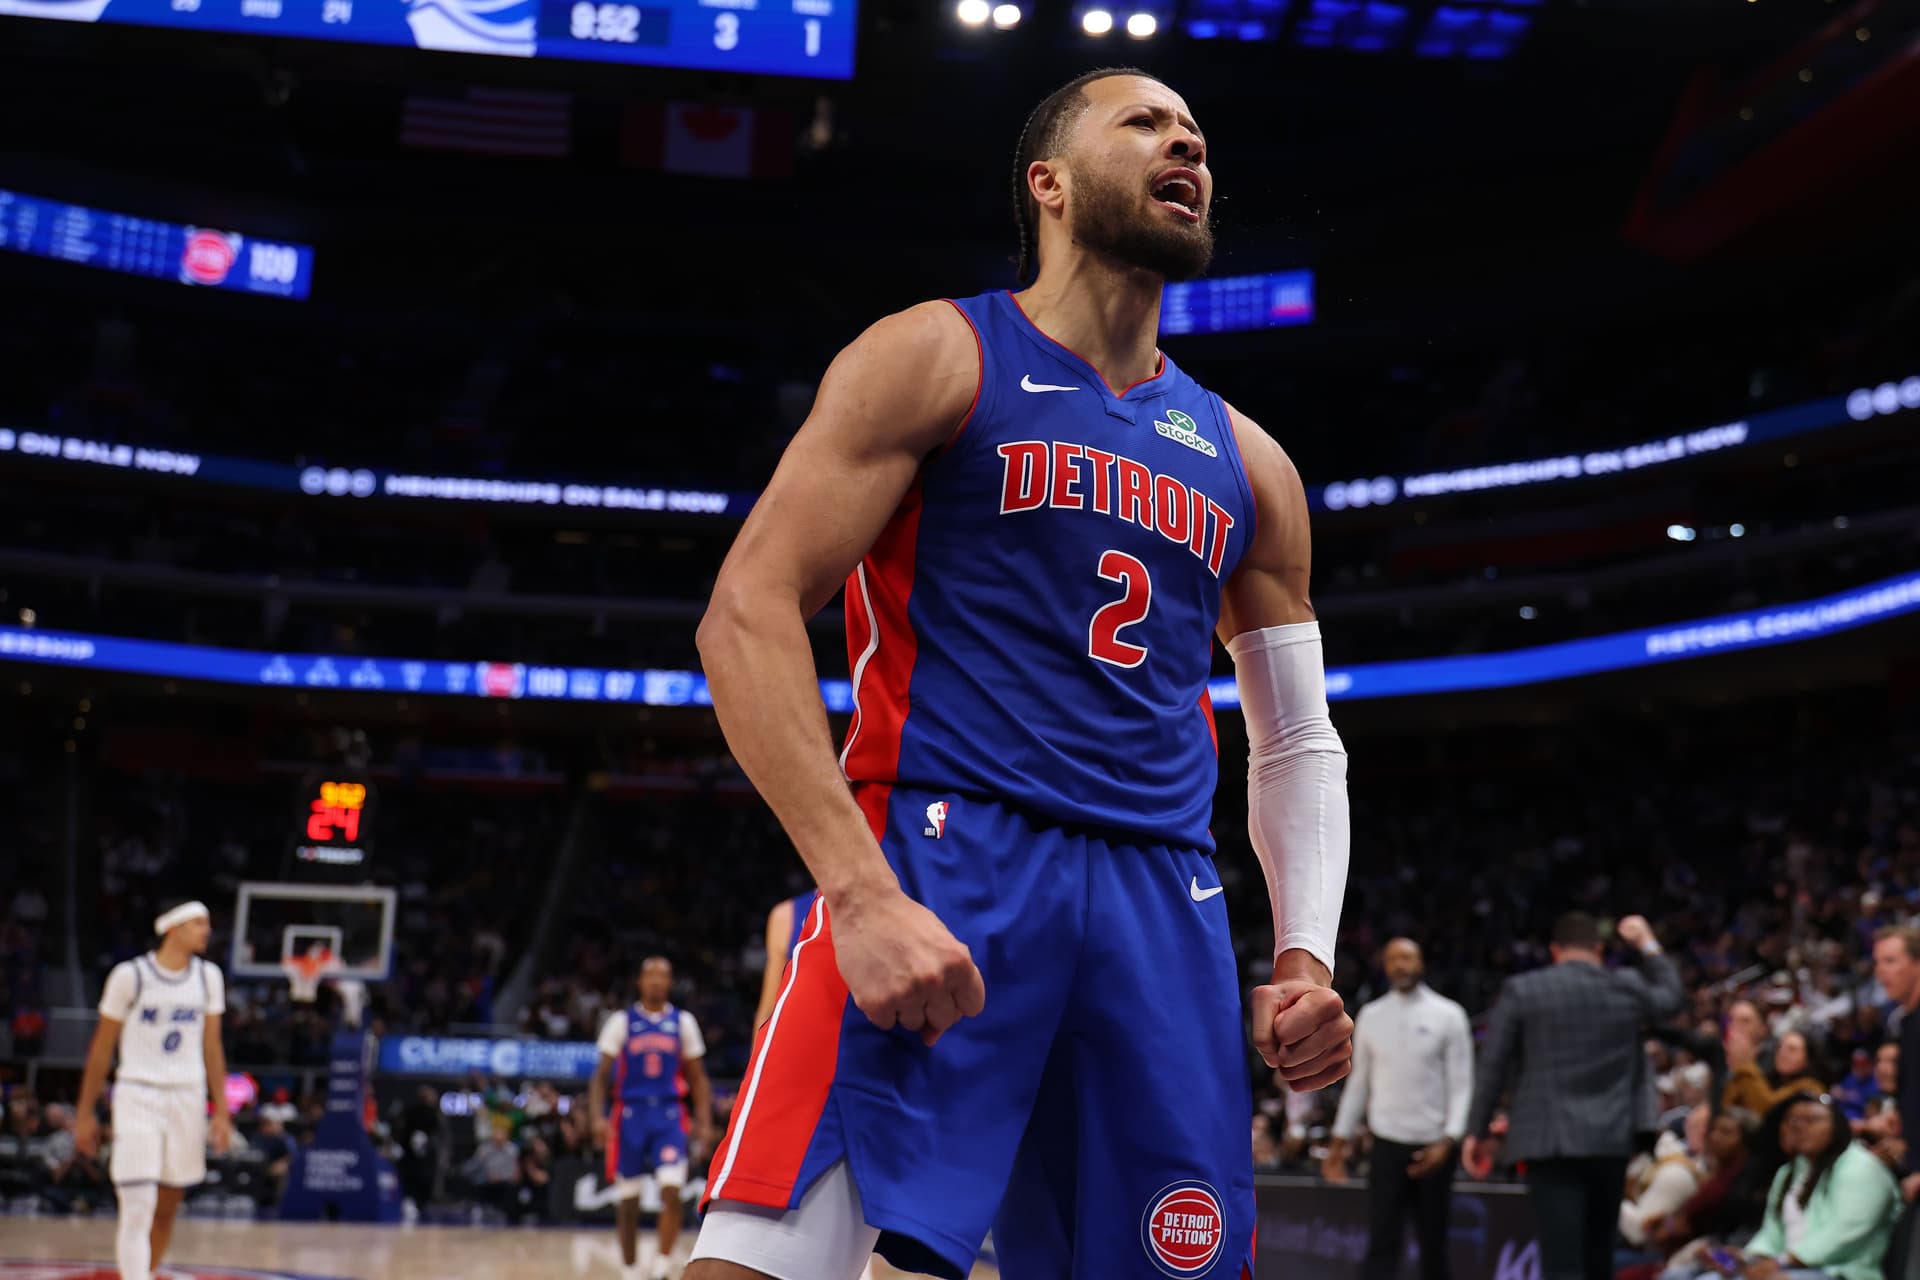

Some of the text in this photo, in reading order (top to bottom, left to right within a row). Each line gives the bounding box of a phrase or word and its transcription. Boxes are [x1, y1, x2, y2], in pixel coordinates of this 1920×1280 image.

[713, 12, 739, 51] 3
[804, 19, 821, 57] 1
[997, 440, 1234, 578] DETROIT
[1088, 550, 1151, 668] 2
[306, 799, 361, 842] 24
[163, 1030, 182, 1053] 0
[1161, 1227, 1214, 1246] PISTONS
[1163, 1212, 1214, 1230] DETROIT
